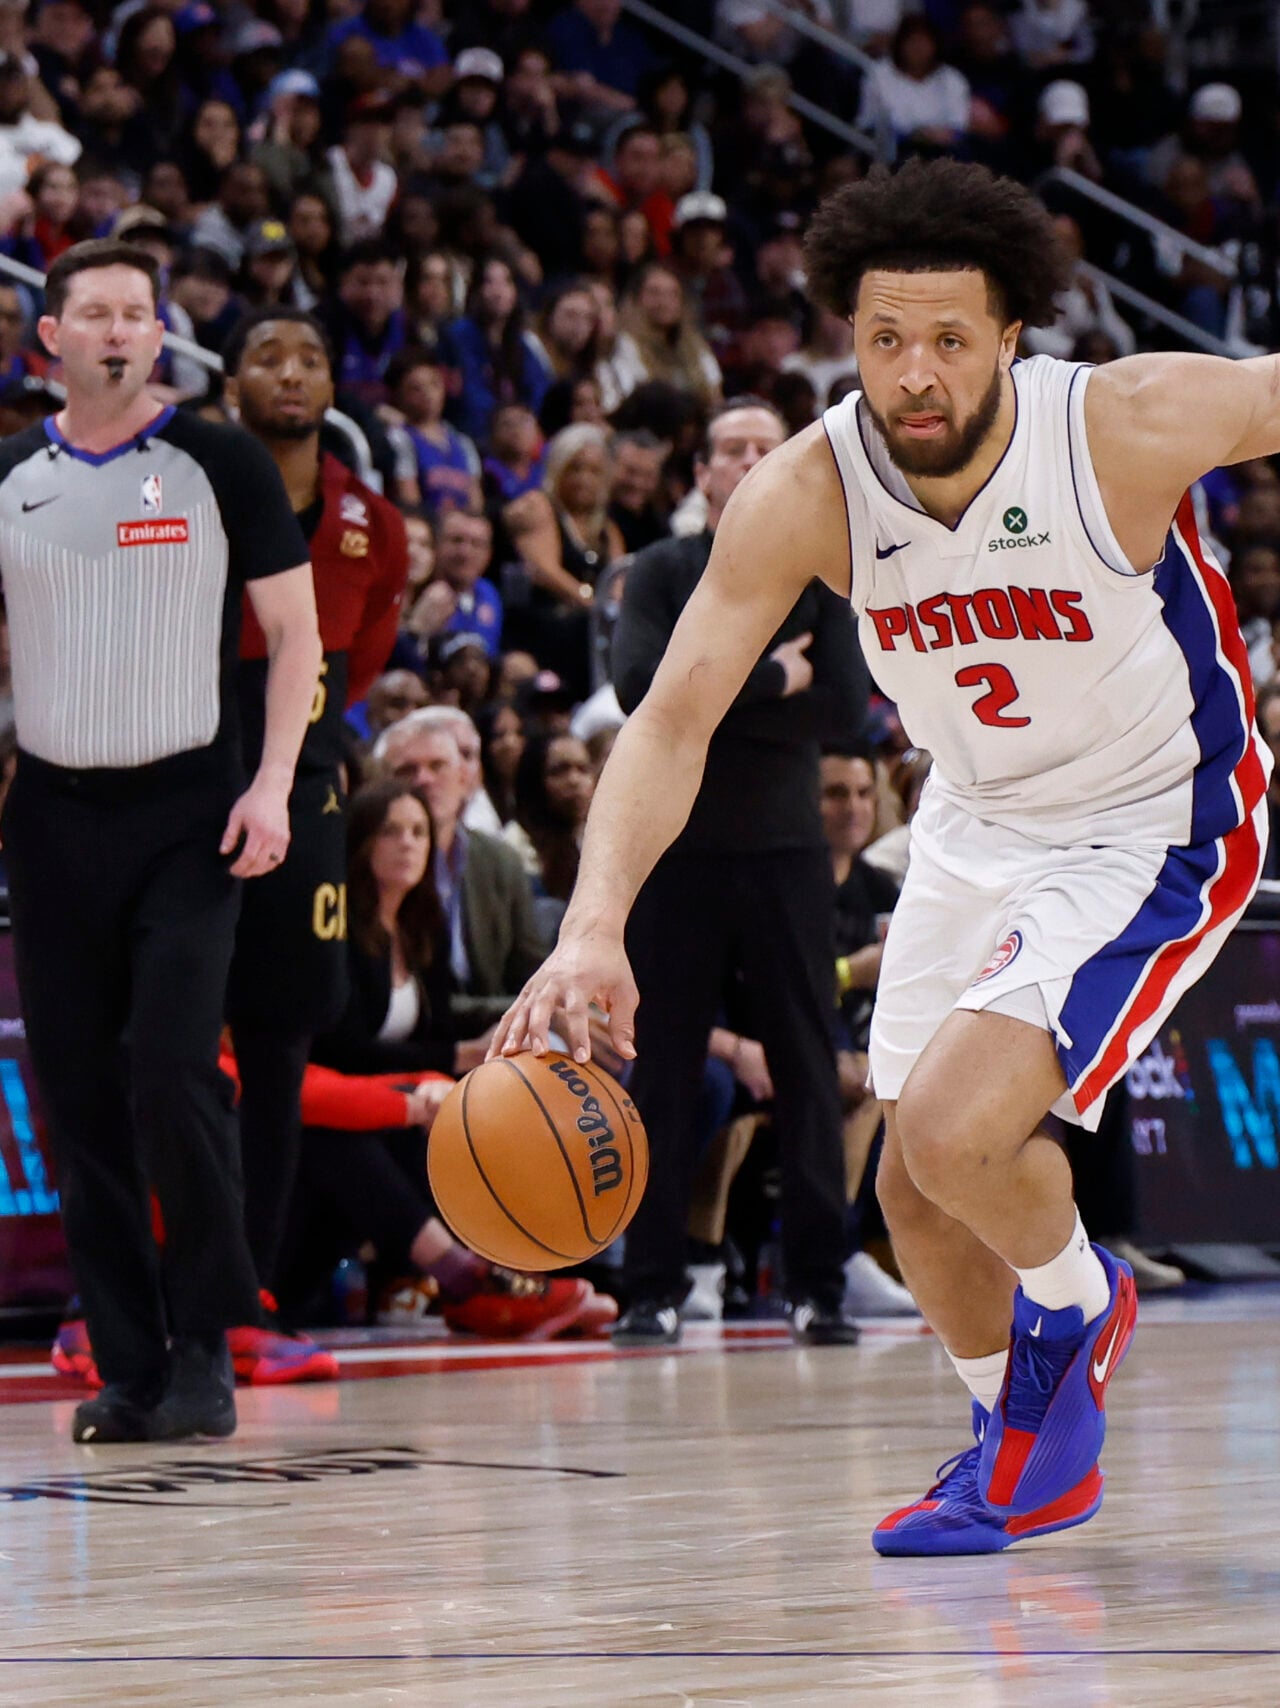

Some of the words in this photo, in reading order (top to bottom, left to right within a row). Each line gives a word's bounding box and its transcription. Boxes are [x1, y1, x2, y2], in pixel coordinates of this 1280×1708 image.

[119, 523, 186, 543] Emirates
[865, 585, 1094, 653] PISTONS
[955, 663, 1031, 728] 2
[549, 1061, 623, 1196] Wilson
